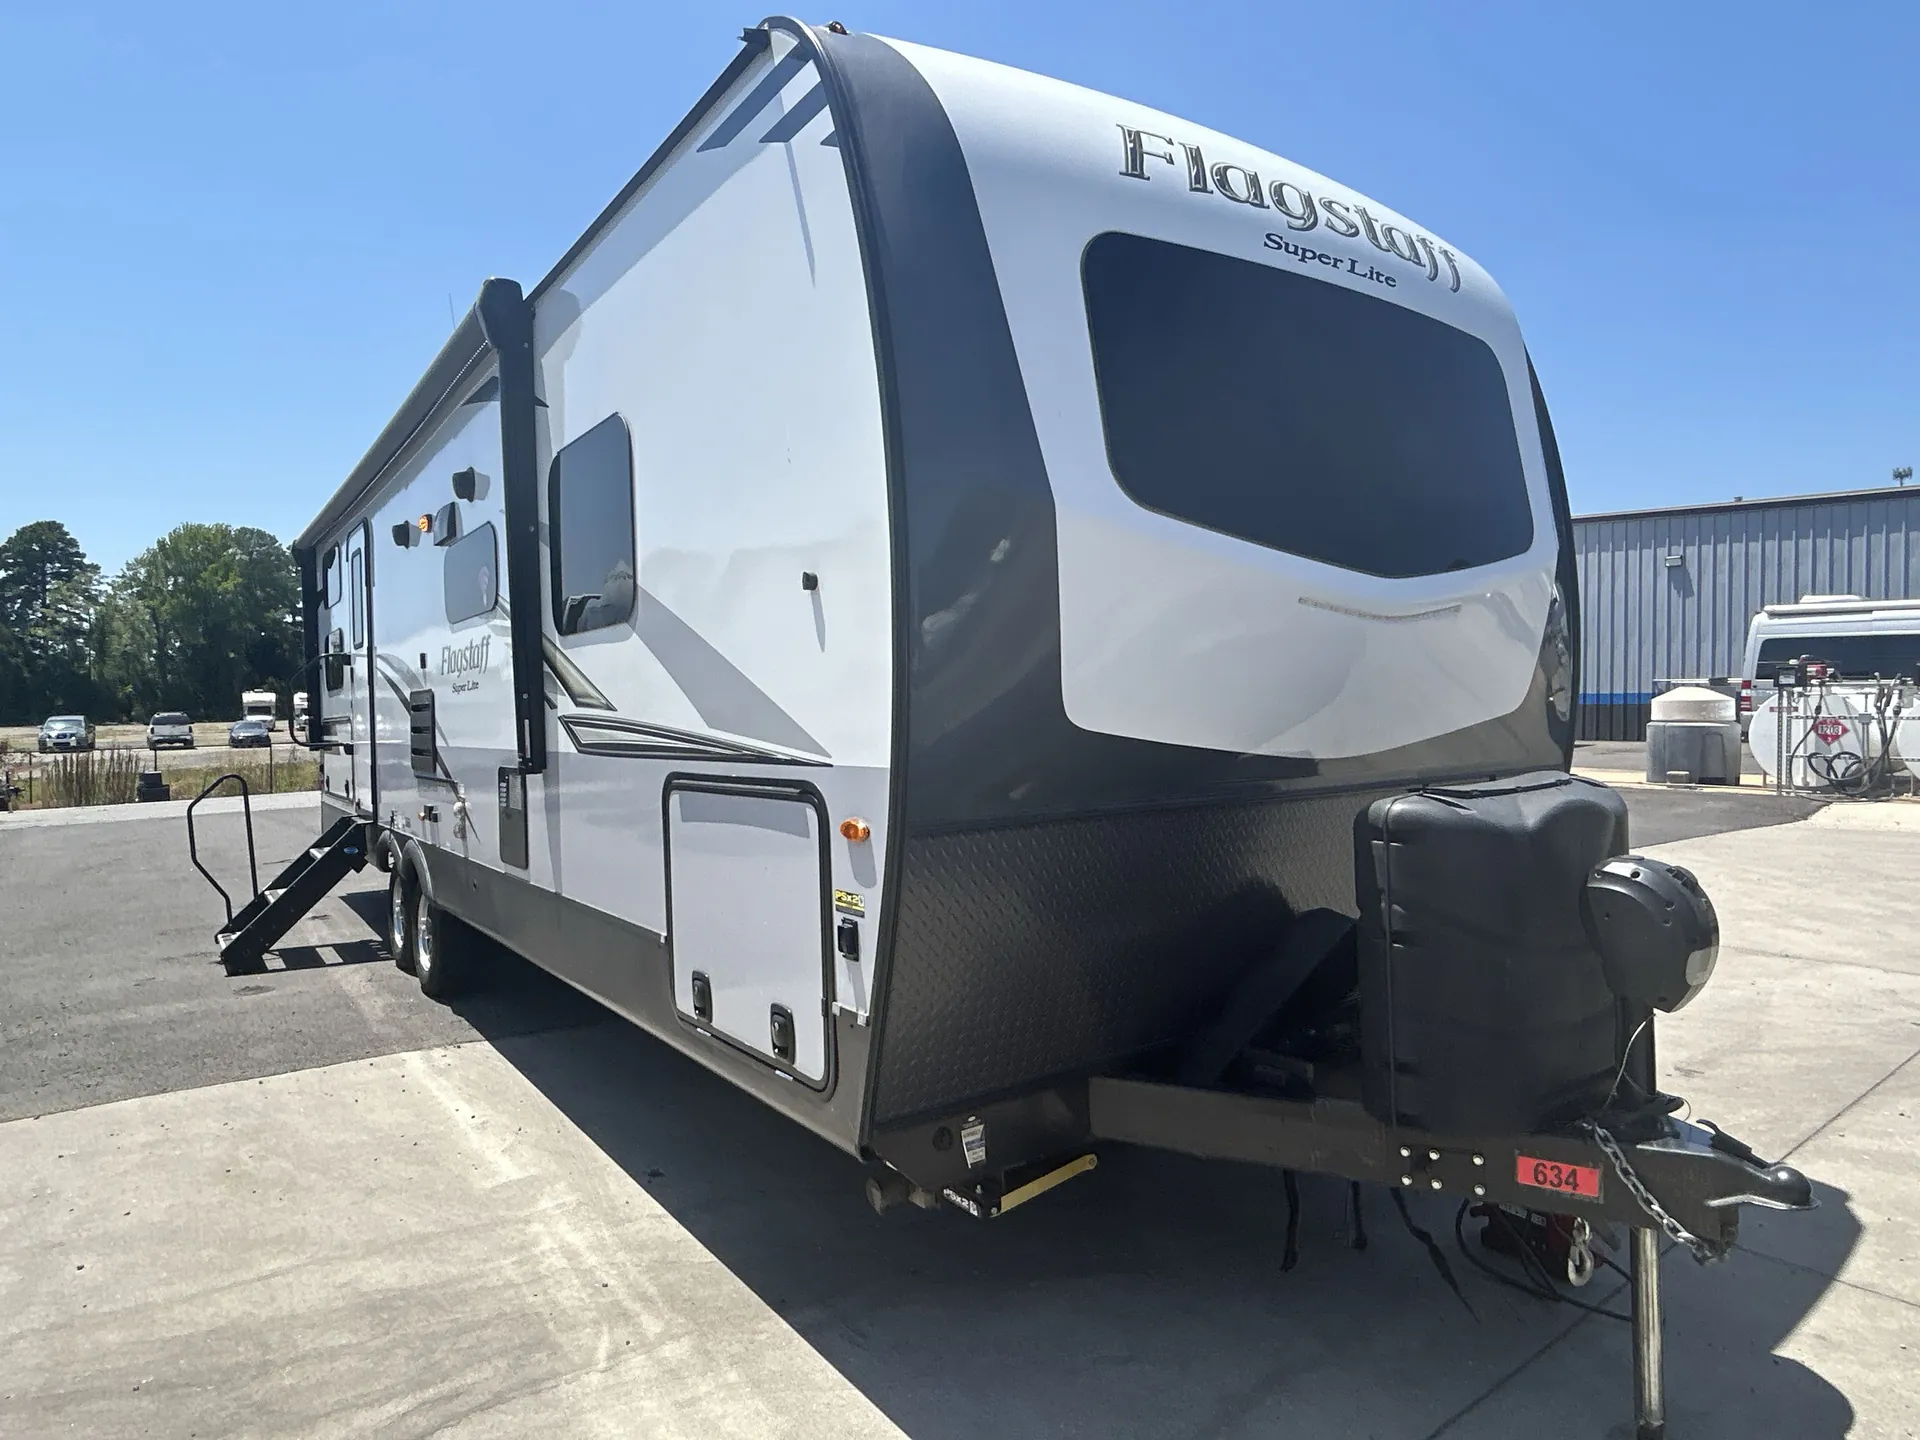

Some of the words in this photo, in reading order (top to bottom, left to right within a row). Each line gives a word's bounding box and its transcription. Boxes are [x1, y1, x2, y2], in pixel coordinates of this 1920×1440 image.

[1115, 123, 1461, 293] Flagstaff
[1263, 232, 1344, 270] Super
[1347, 256, 1397, 289] Lite
[440, 634, 492, 679] Flagstaff
[452, 683, 467, 695] Super
[467, 680, 480, 691] Lite
[1820, 725, 1840, 734] 1203
[1533, 1162, 1579, 1191] 634
